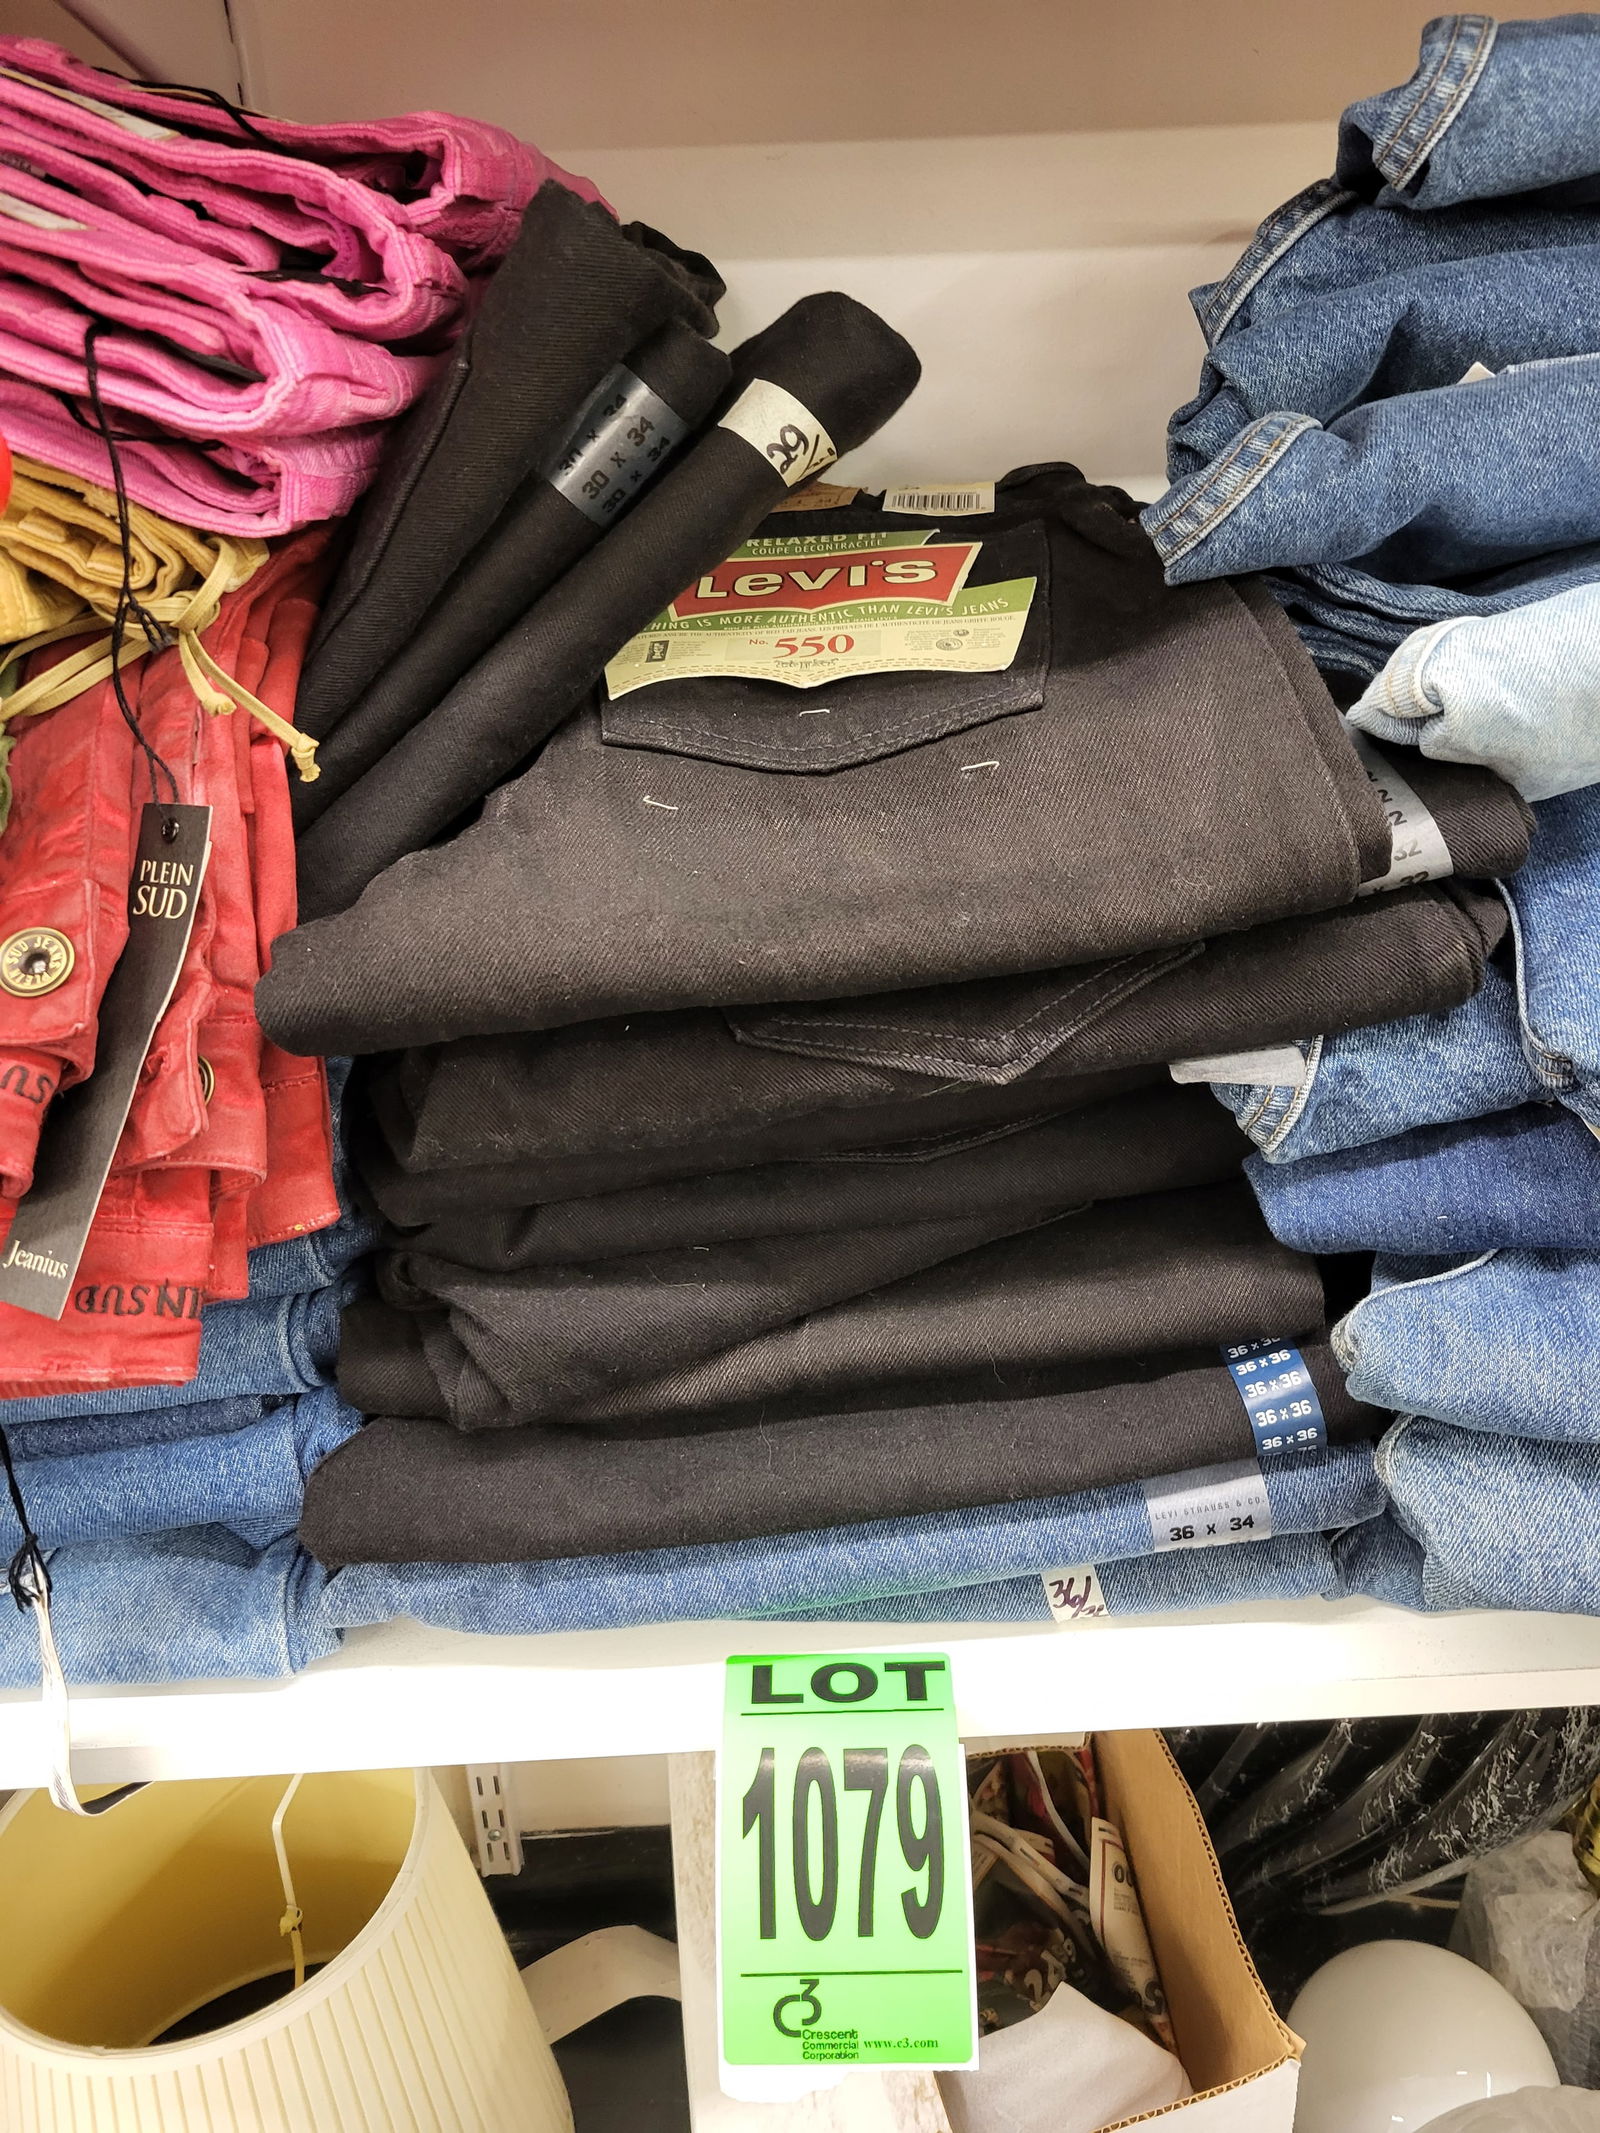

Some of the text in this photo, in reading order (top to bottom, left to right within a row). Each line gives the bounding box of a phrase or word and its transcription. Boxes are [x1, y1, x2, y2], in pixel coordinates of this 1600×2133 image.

[582, 470, 610, 499] 30
[626, 416, 655, 447] 34
[602, 489, 626, 513] 30
[747, 534, 847, 547] RELAXED
[752, 547, 789, 555] COUPE
[643, 598, 1009, 631] HING IS MORE AUTHENTIC THAN LEVI'S JEANS
[772, 634, 854, 658] 550
[140, 859, 194, 886] PLEIN
[132, 885, 188, 919] SUD
[0, 1065, 54, 1104] SU
[2, 1239, 69, 1280] Jeanius
[75, 1283, 151, 1316] SUD
[1228, 1345, 1249, 1359] 36
[1235, 1361, 1257, 1376] 36
[1268, 1349, 1291, 1364] 36
[1245, 1381, 1267, 1398] 36
[1279, 1370, 1301, 1388] 36
[1255, 1409, 1277, 1427] 36
[1290, 1399, 1312, 1418] 36
[1262, 1436, 1283, 1450] 36
[1296, 1427, 1318, 1442] 36
[1155, 1510, 1178, 1521] LEVI
[1184, 1501, 1230, 1516] STRAUSS
[1169, 1525, 1195, 1542] 36
[1229, 1514, 1255, 1531] 34
[751, 1661, 945, 1704] LOT
[742, 1744, 945, 1942] 1079
[802, 2029, 859, 2040] Crescent
[802, 2041, 859, 2050] Commercial
[864, 2037, 939, 2049] www.c3.com
[802, 2051, 860, 2061] Corporation
